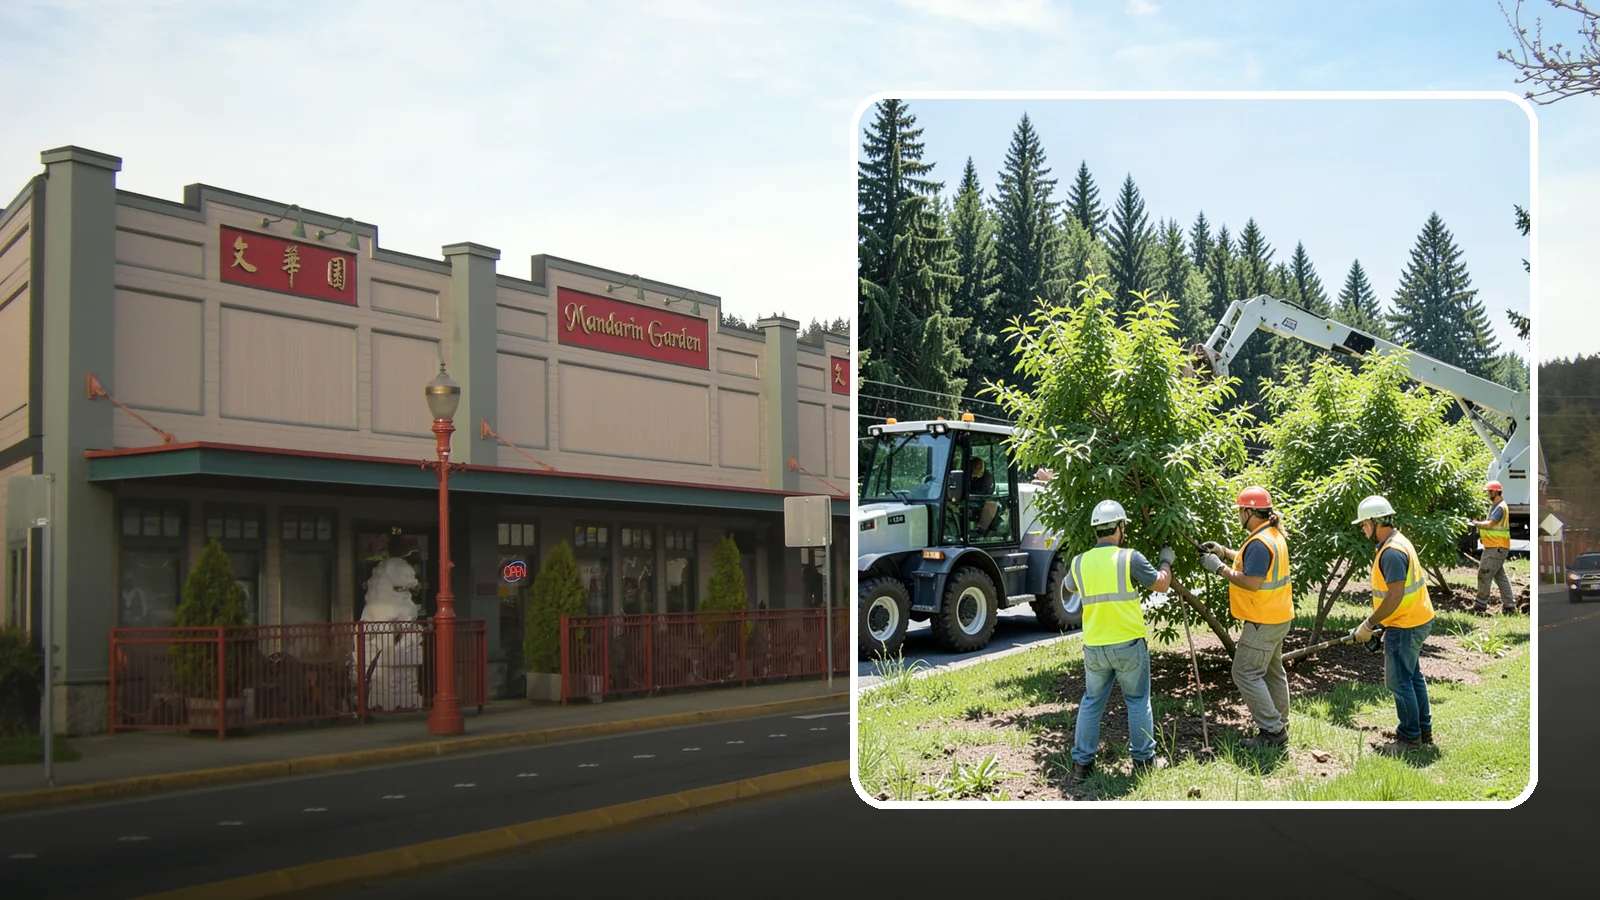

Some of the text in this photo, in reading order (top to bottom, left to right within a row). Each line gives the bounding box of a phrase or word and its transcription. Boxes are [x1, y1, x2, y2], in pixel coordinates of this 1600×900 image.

[230, 235, 347, 291] 文華園
[565, 302, 702, 352] Mandarin Garden
[503, 565, 527, 578] OPEN
